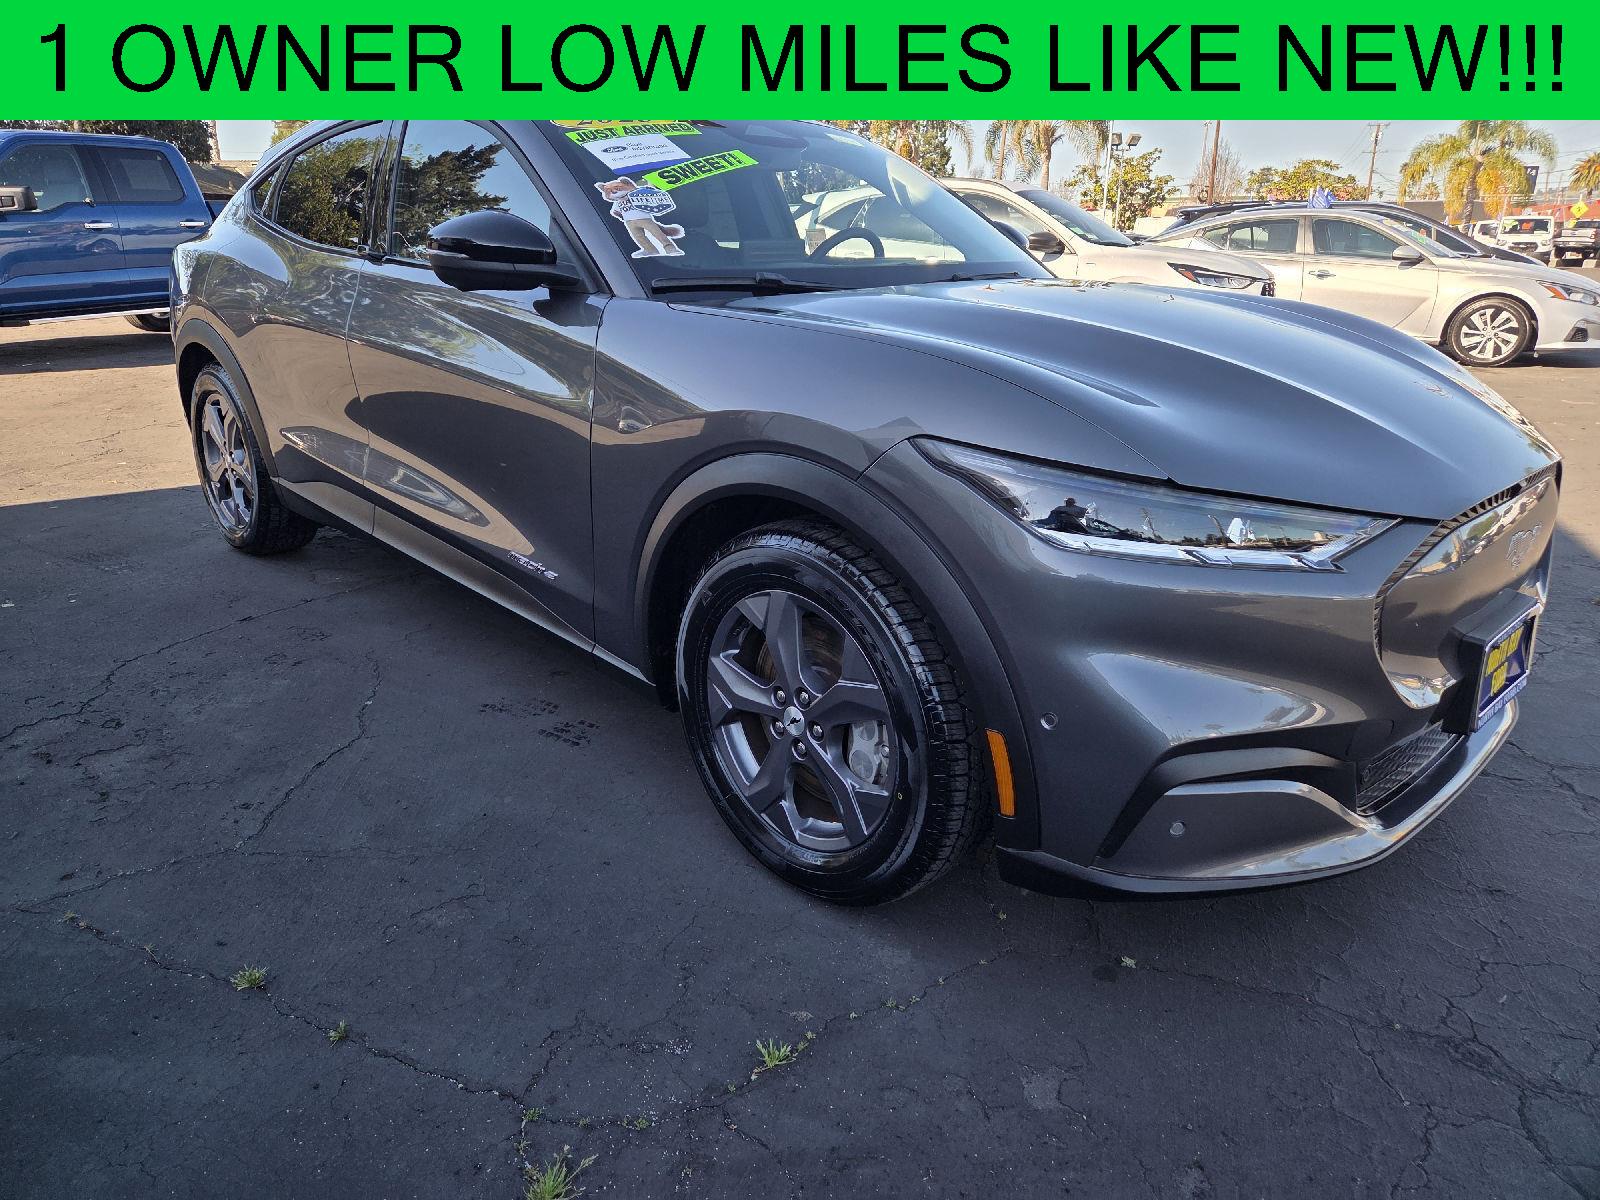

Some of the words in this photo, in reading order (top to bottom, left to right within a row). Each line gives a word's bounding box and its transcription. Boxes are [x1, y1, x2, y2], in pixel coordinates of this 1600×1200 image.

[576, 127, 618, 143] JUST
[622, 122, 693, 136] ARRIVED
[658, 152, 744, 184] SWEET!
